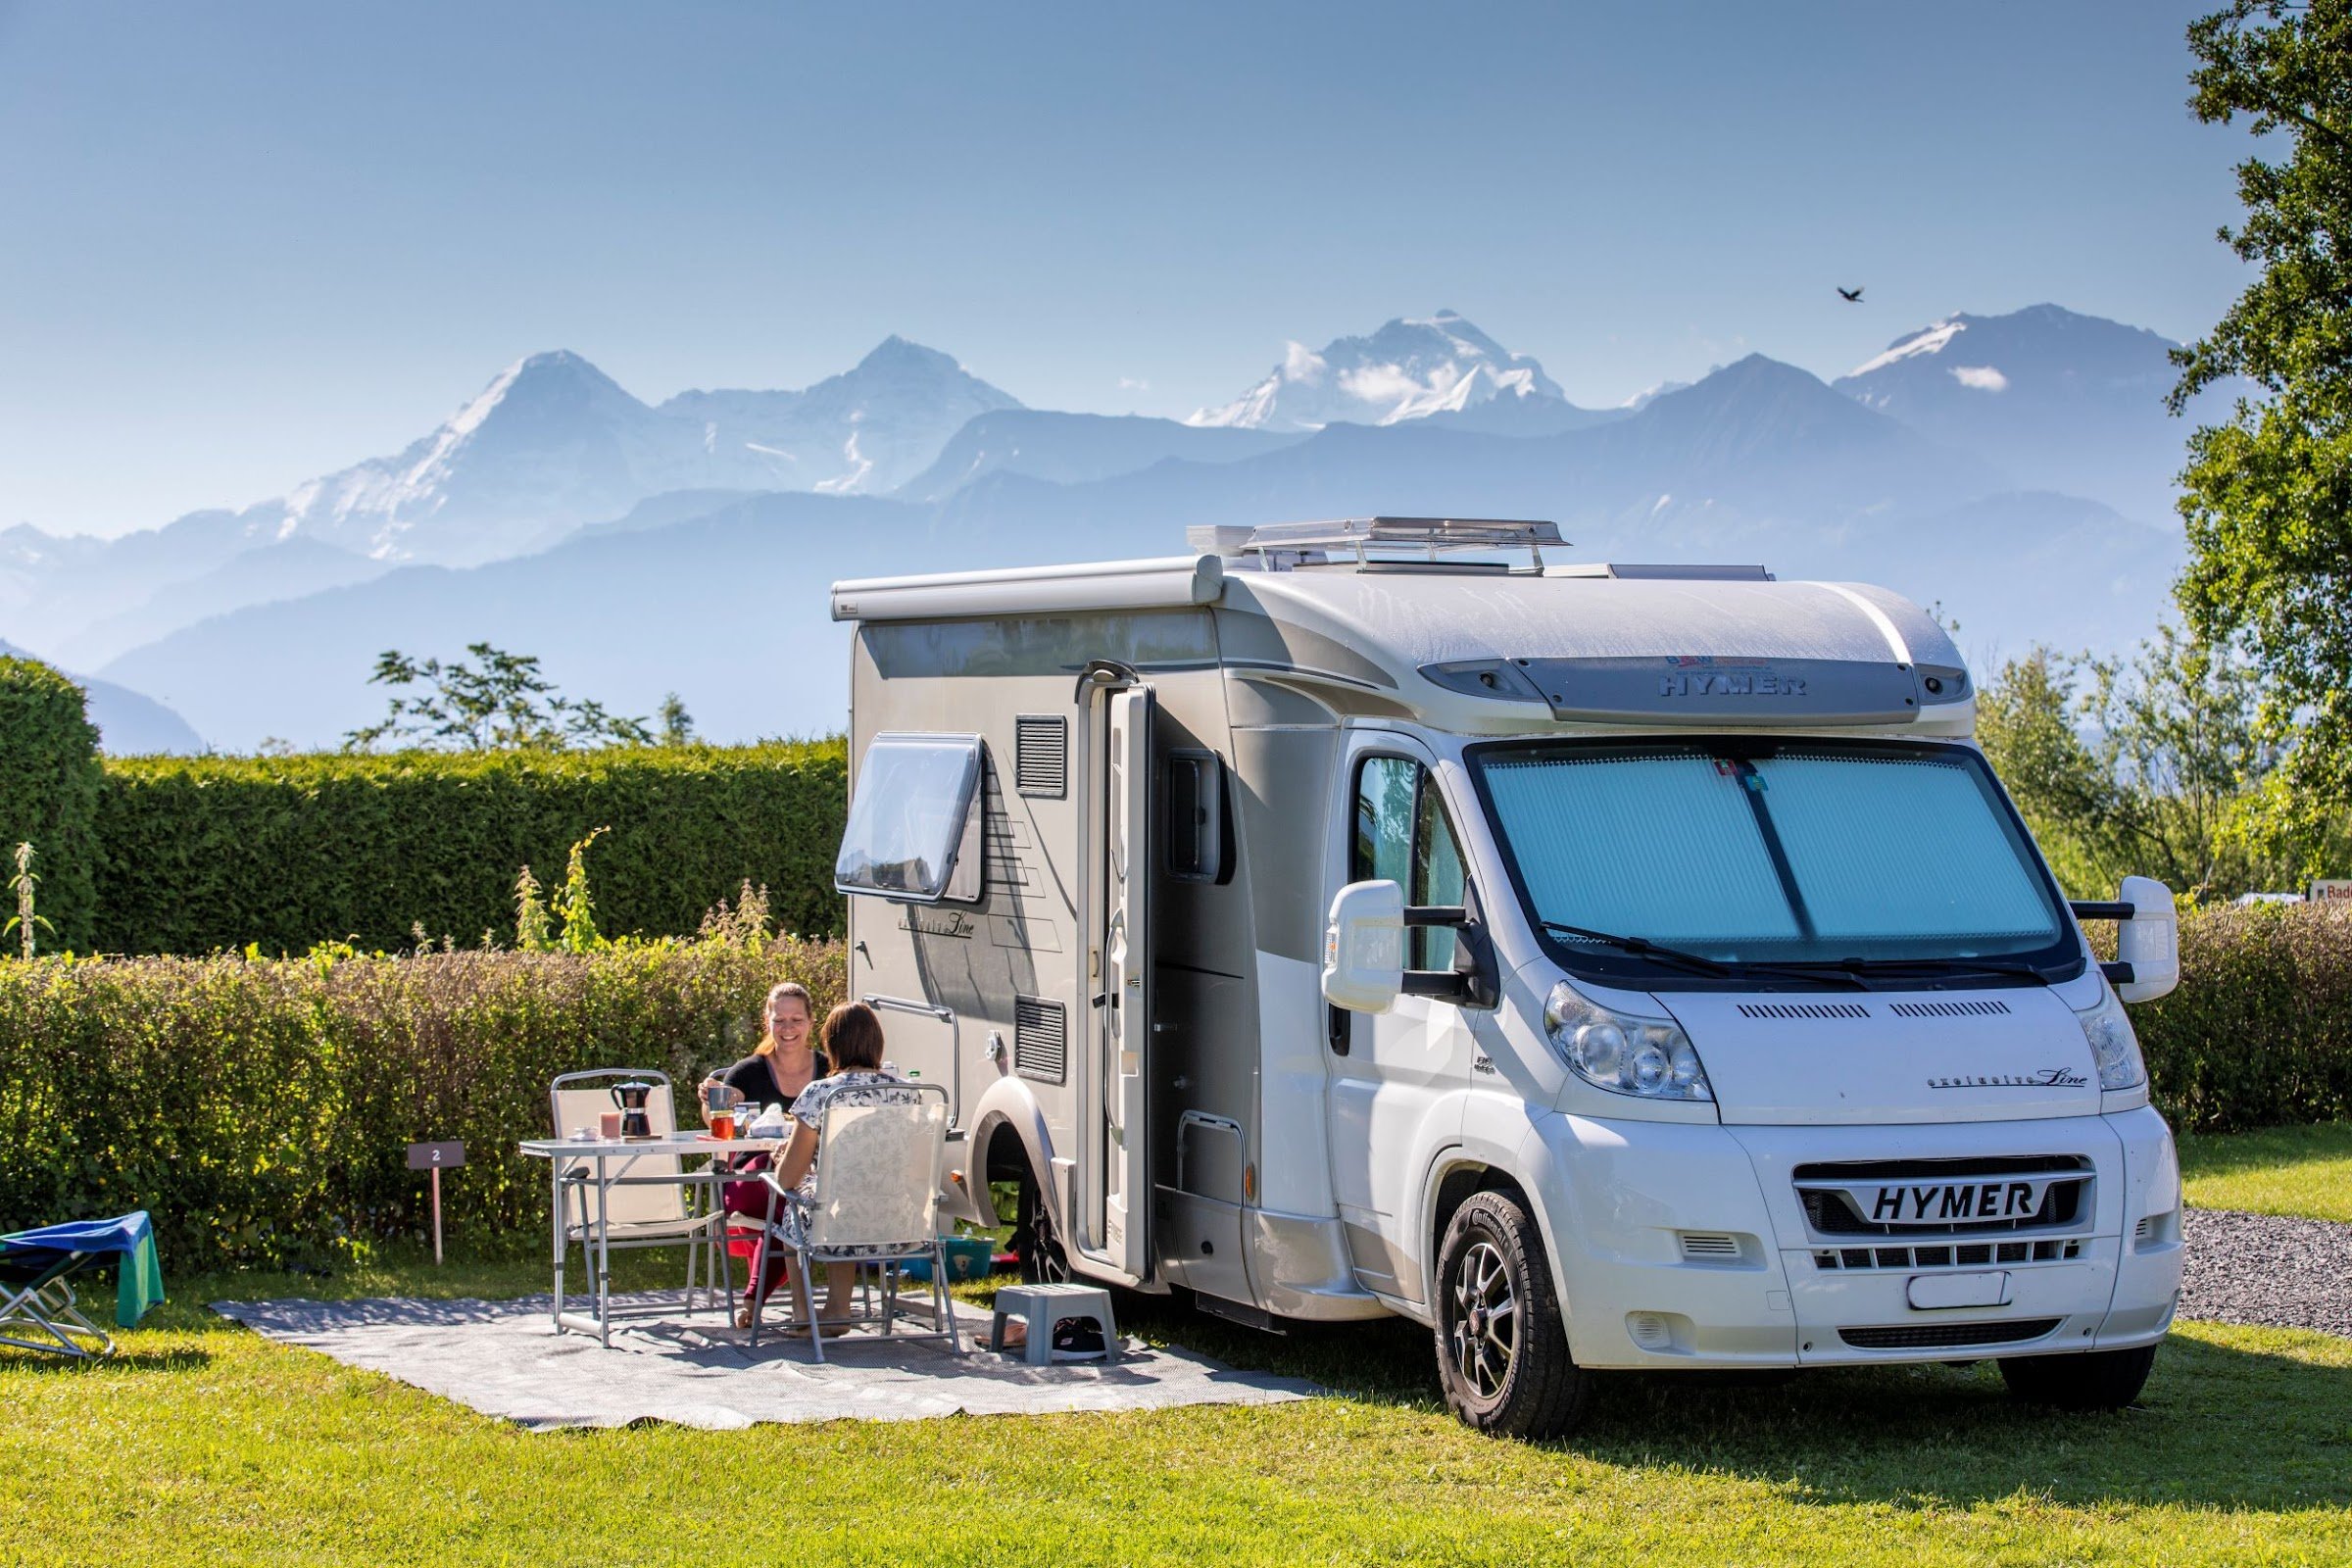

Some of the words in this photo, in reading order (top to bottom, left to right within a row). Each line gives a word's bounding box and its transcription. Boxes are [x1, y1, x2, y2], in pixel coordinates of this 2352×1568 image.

[1659, 674, 1807, 696] HYMER
[2328, 883, 2352, 899] Bad
[2036, 1066, 2088, 1086] Line
[432, 1150, 441, 1161] 2
[1872, 1182, 2034, 1220] HYMER
[1472, 1208, 1507, 1247] Continental
